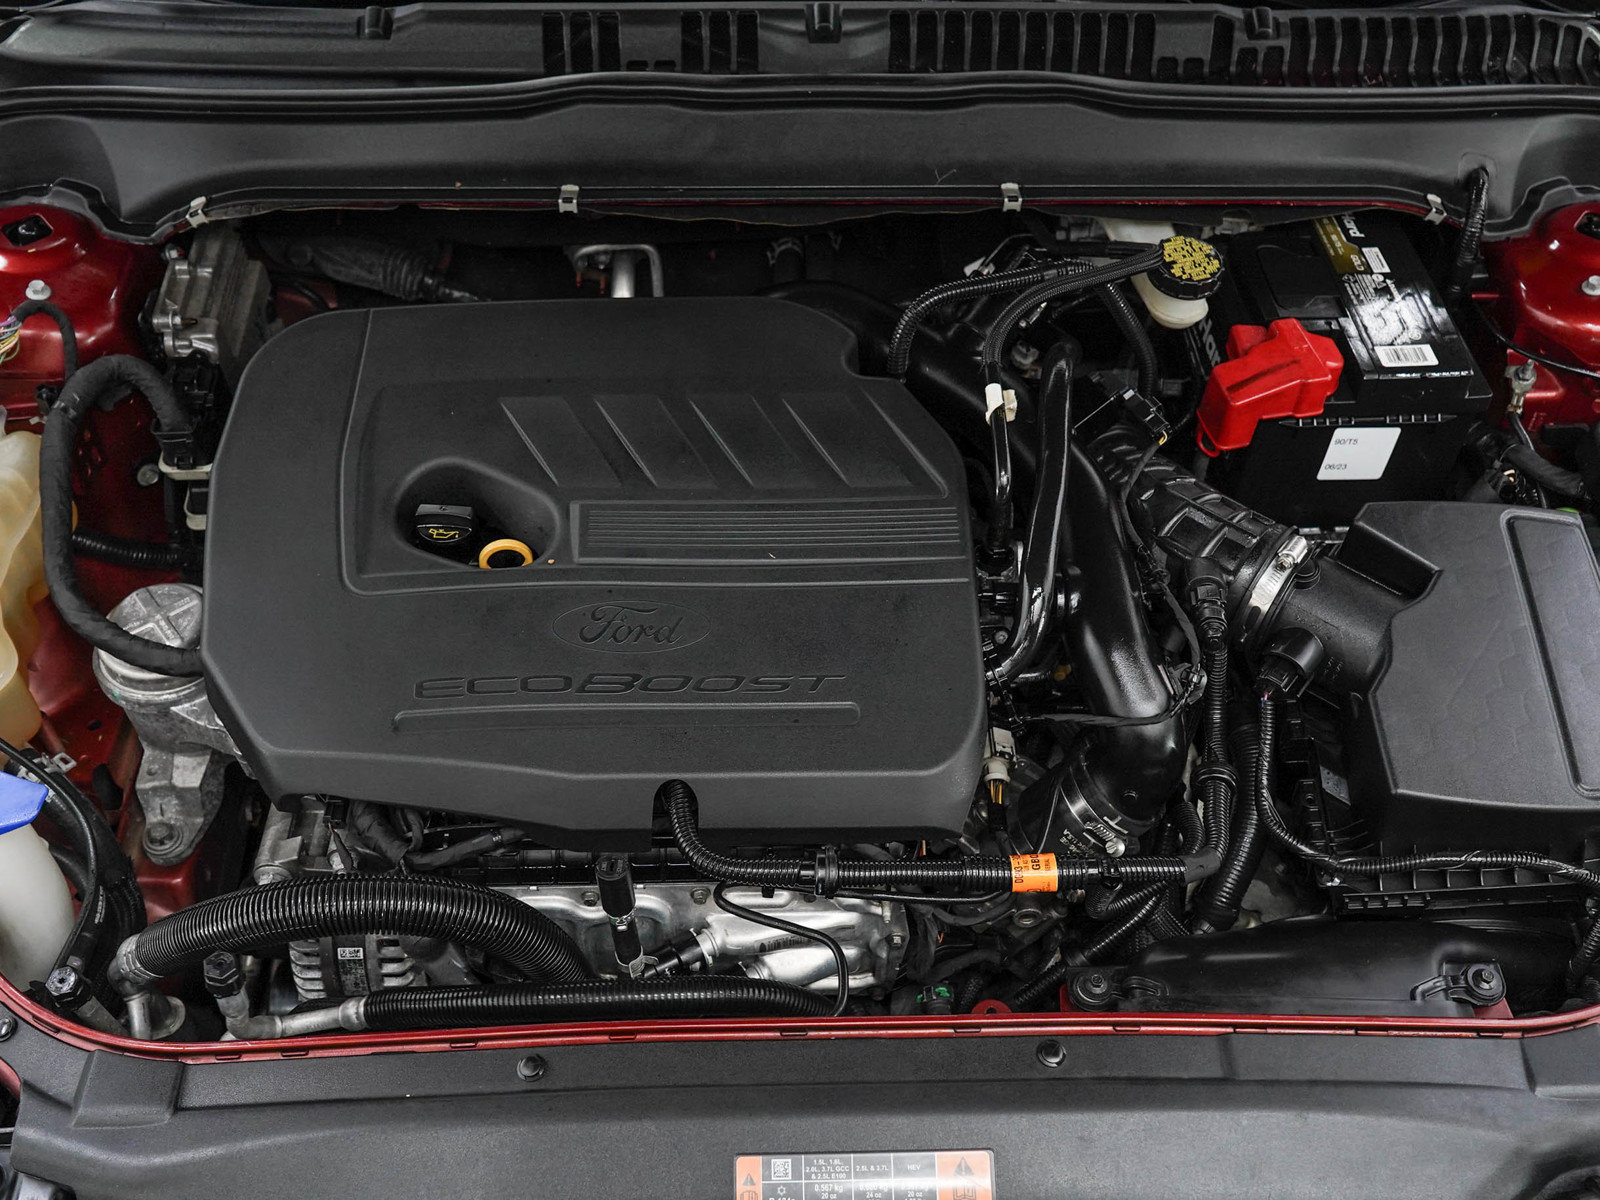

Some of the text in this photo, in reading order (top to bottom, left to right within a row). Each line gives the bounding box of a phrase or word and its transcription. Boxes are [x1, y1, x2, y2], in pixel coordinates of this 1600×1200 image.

[1350, 254, 1364, 271] GOLD
[579, 605, 683, 644] Ford
[414, 672, 846, 699] ECOBOOST
[814, 1183, 844, 1193] 0.567 kg
